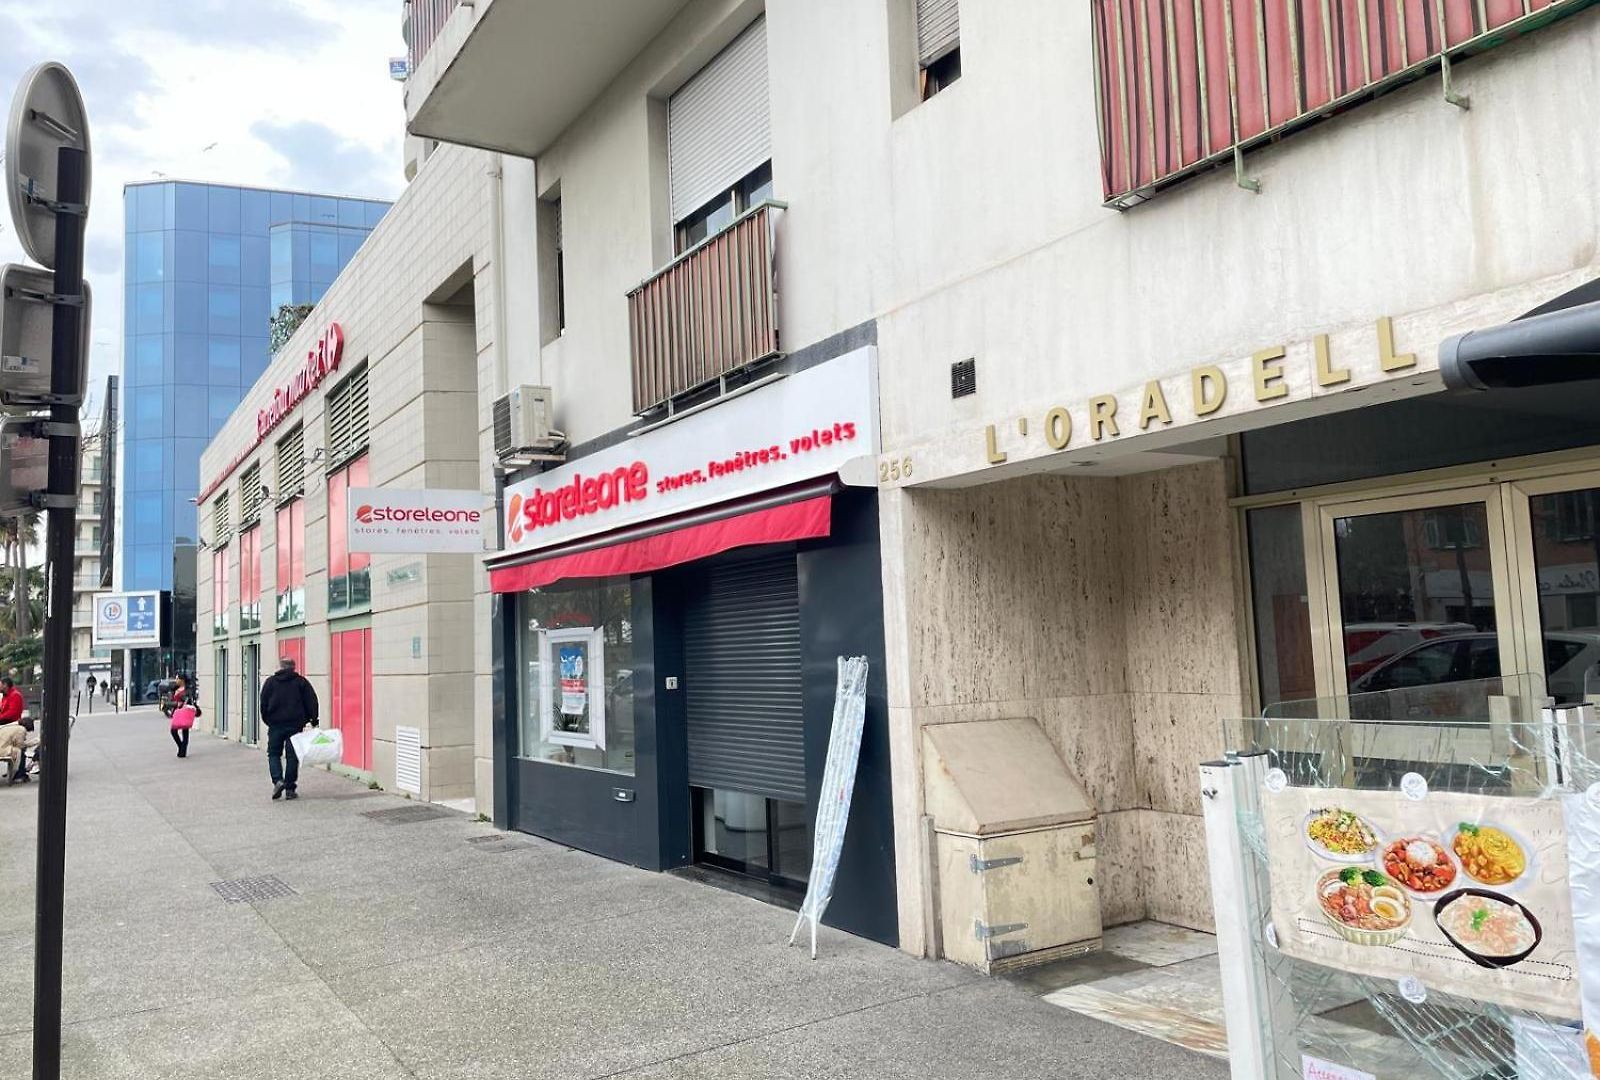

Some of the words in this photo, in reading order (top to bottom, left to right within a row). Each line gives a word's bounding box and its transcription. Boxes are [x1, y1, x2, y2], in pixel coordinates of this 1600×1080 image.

[985, 316, 1417, 463] L'ORADELL
[523, 461, 648, 531] storeleone
[790, 422, 856, 454] volets
[880, 457, 913, 482] 256
[373, 506, 480, 522] storeleone
